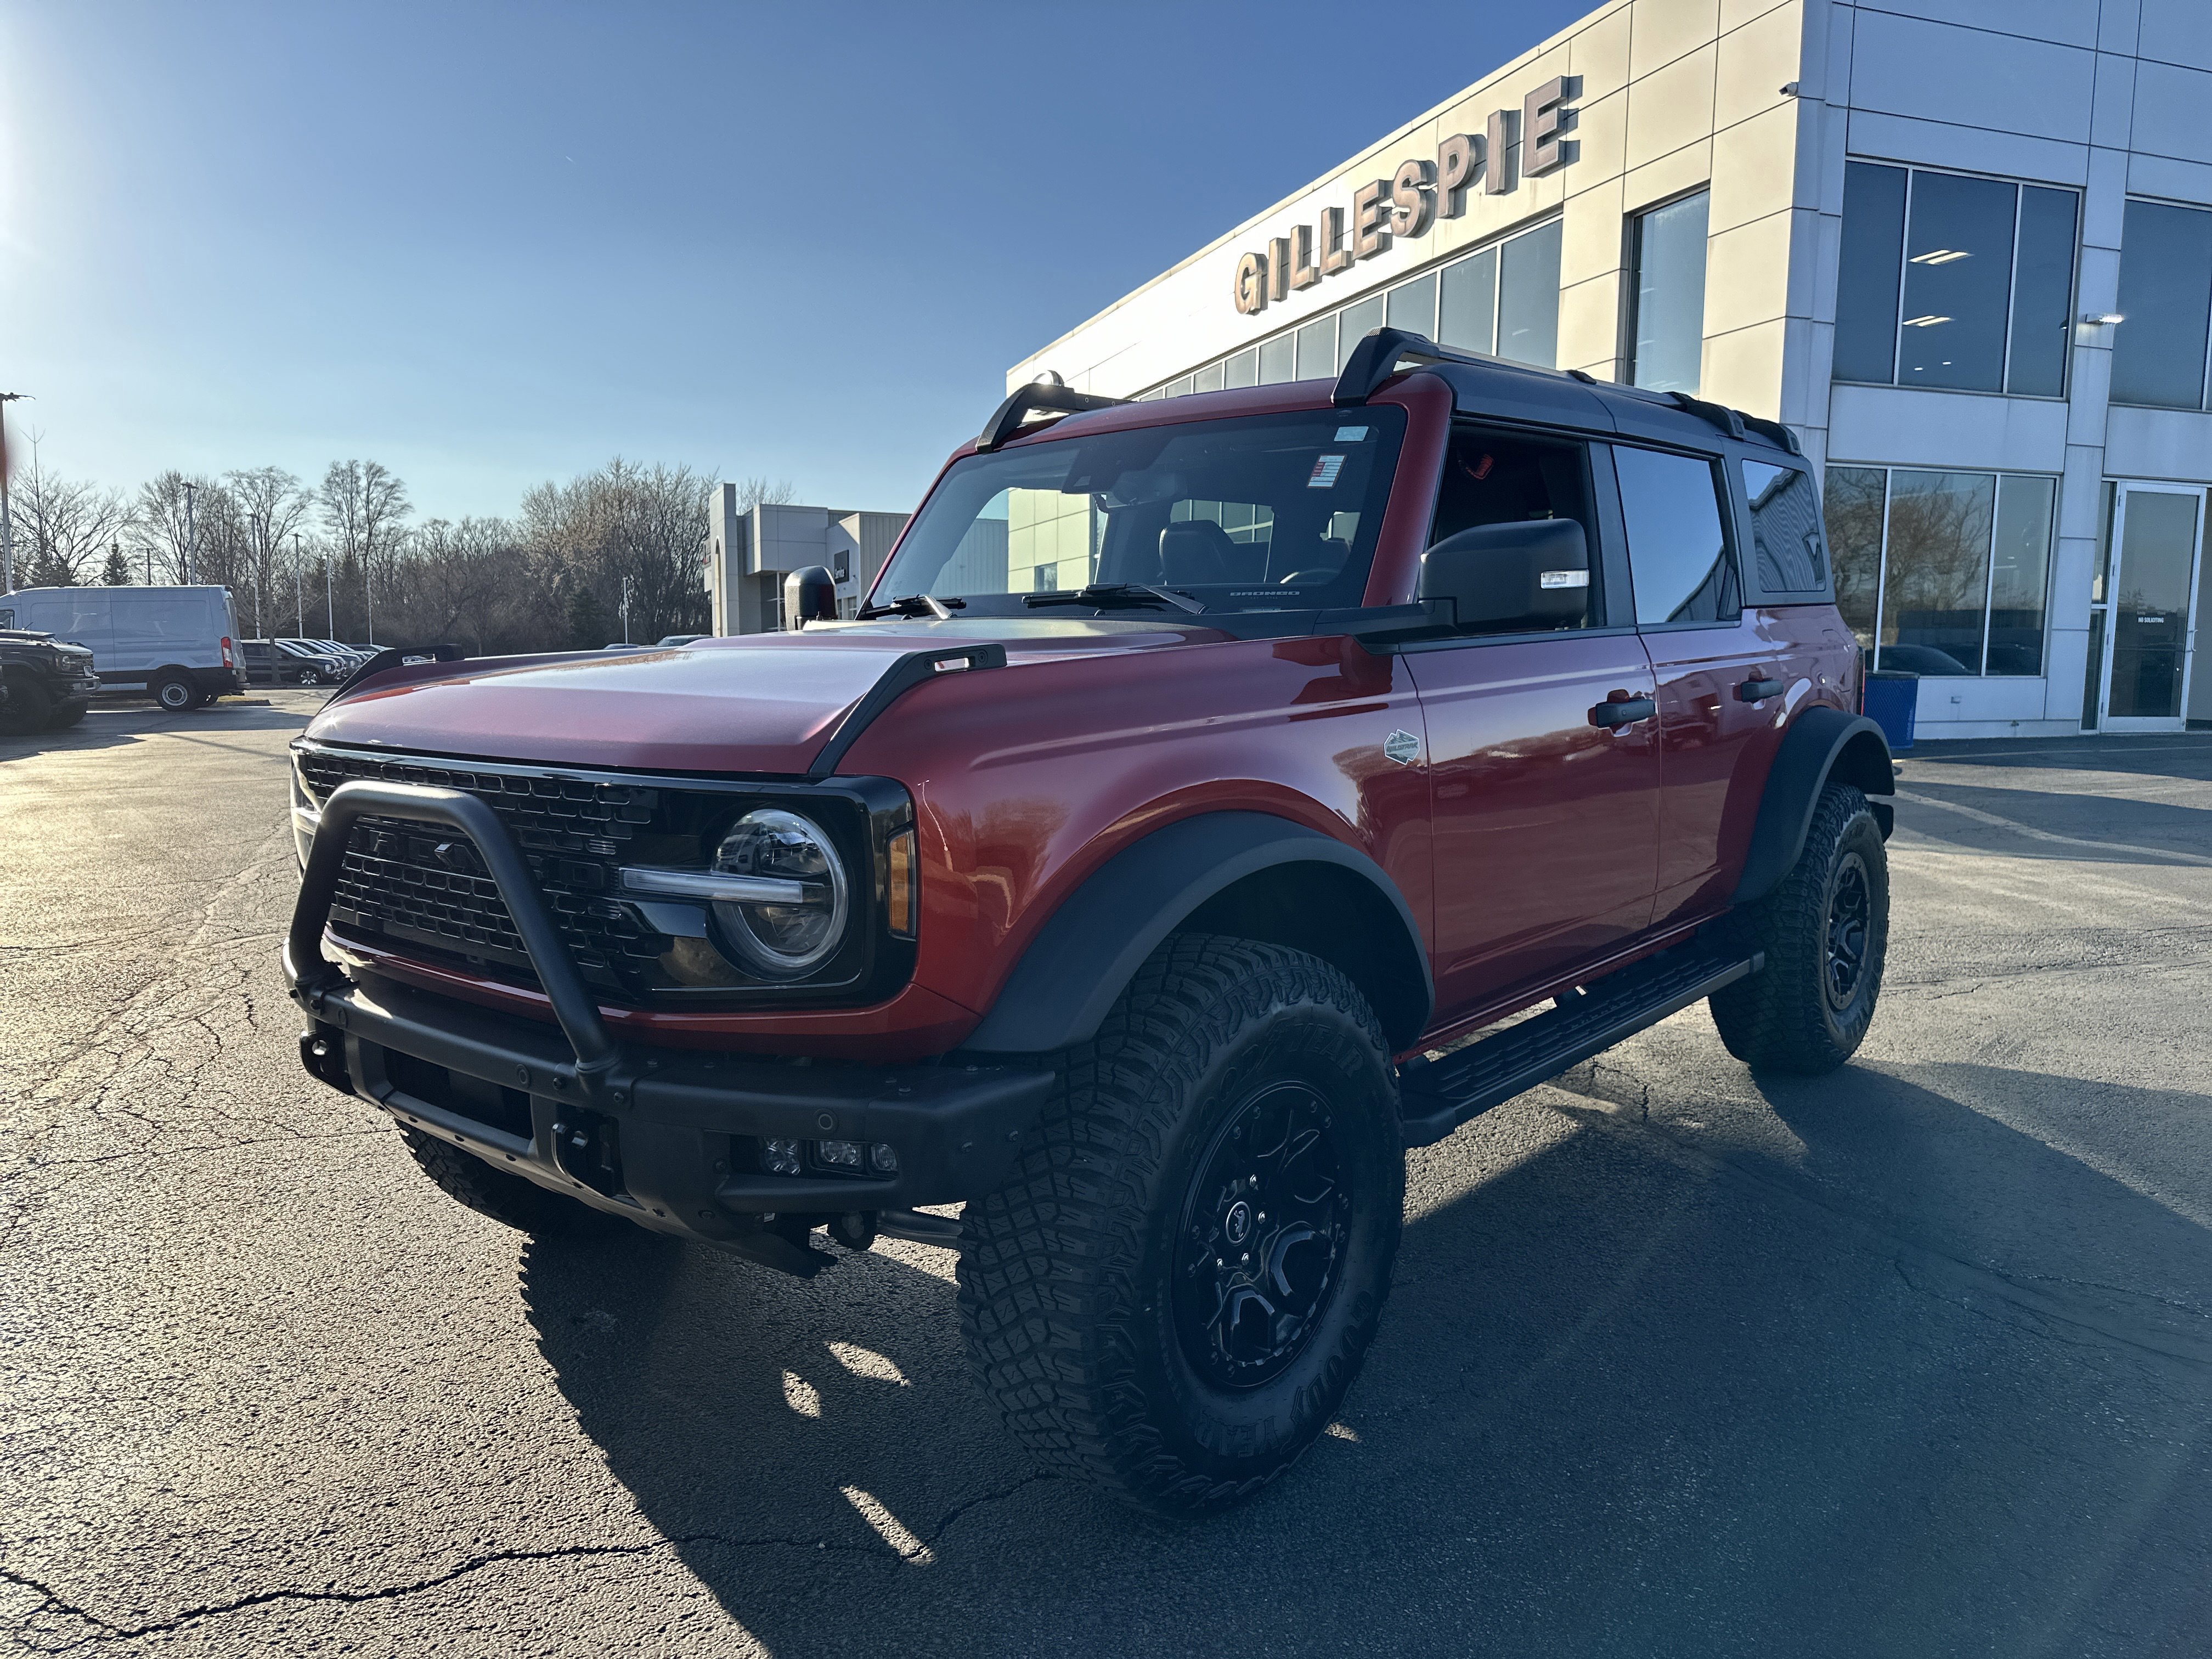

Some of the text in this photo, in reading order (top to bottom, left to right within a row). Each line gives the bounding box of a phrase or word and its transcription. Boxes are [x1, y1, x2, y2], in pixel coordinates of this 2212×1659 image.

[1234, 75, 1582, 315] GILLESPIE
[1386, 741, 1418, 753] WILDTRAK
[1195, 1291, 1372, 1458] GOODYEAR
